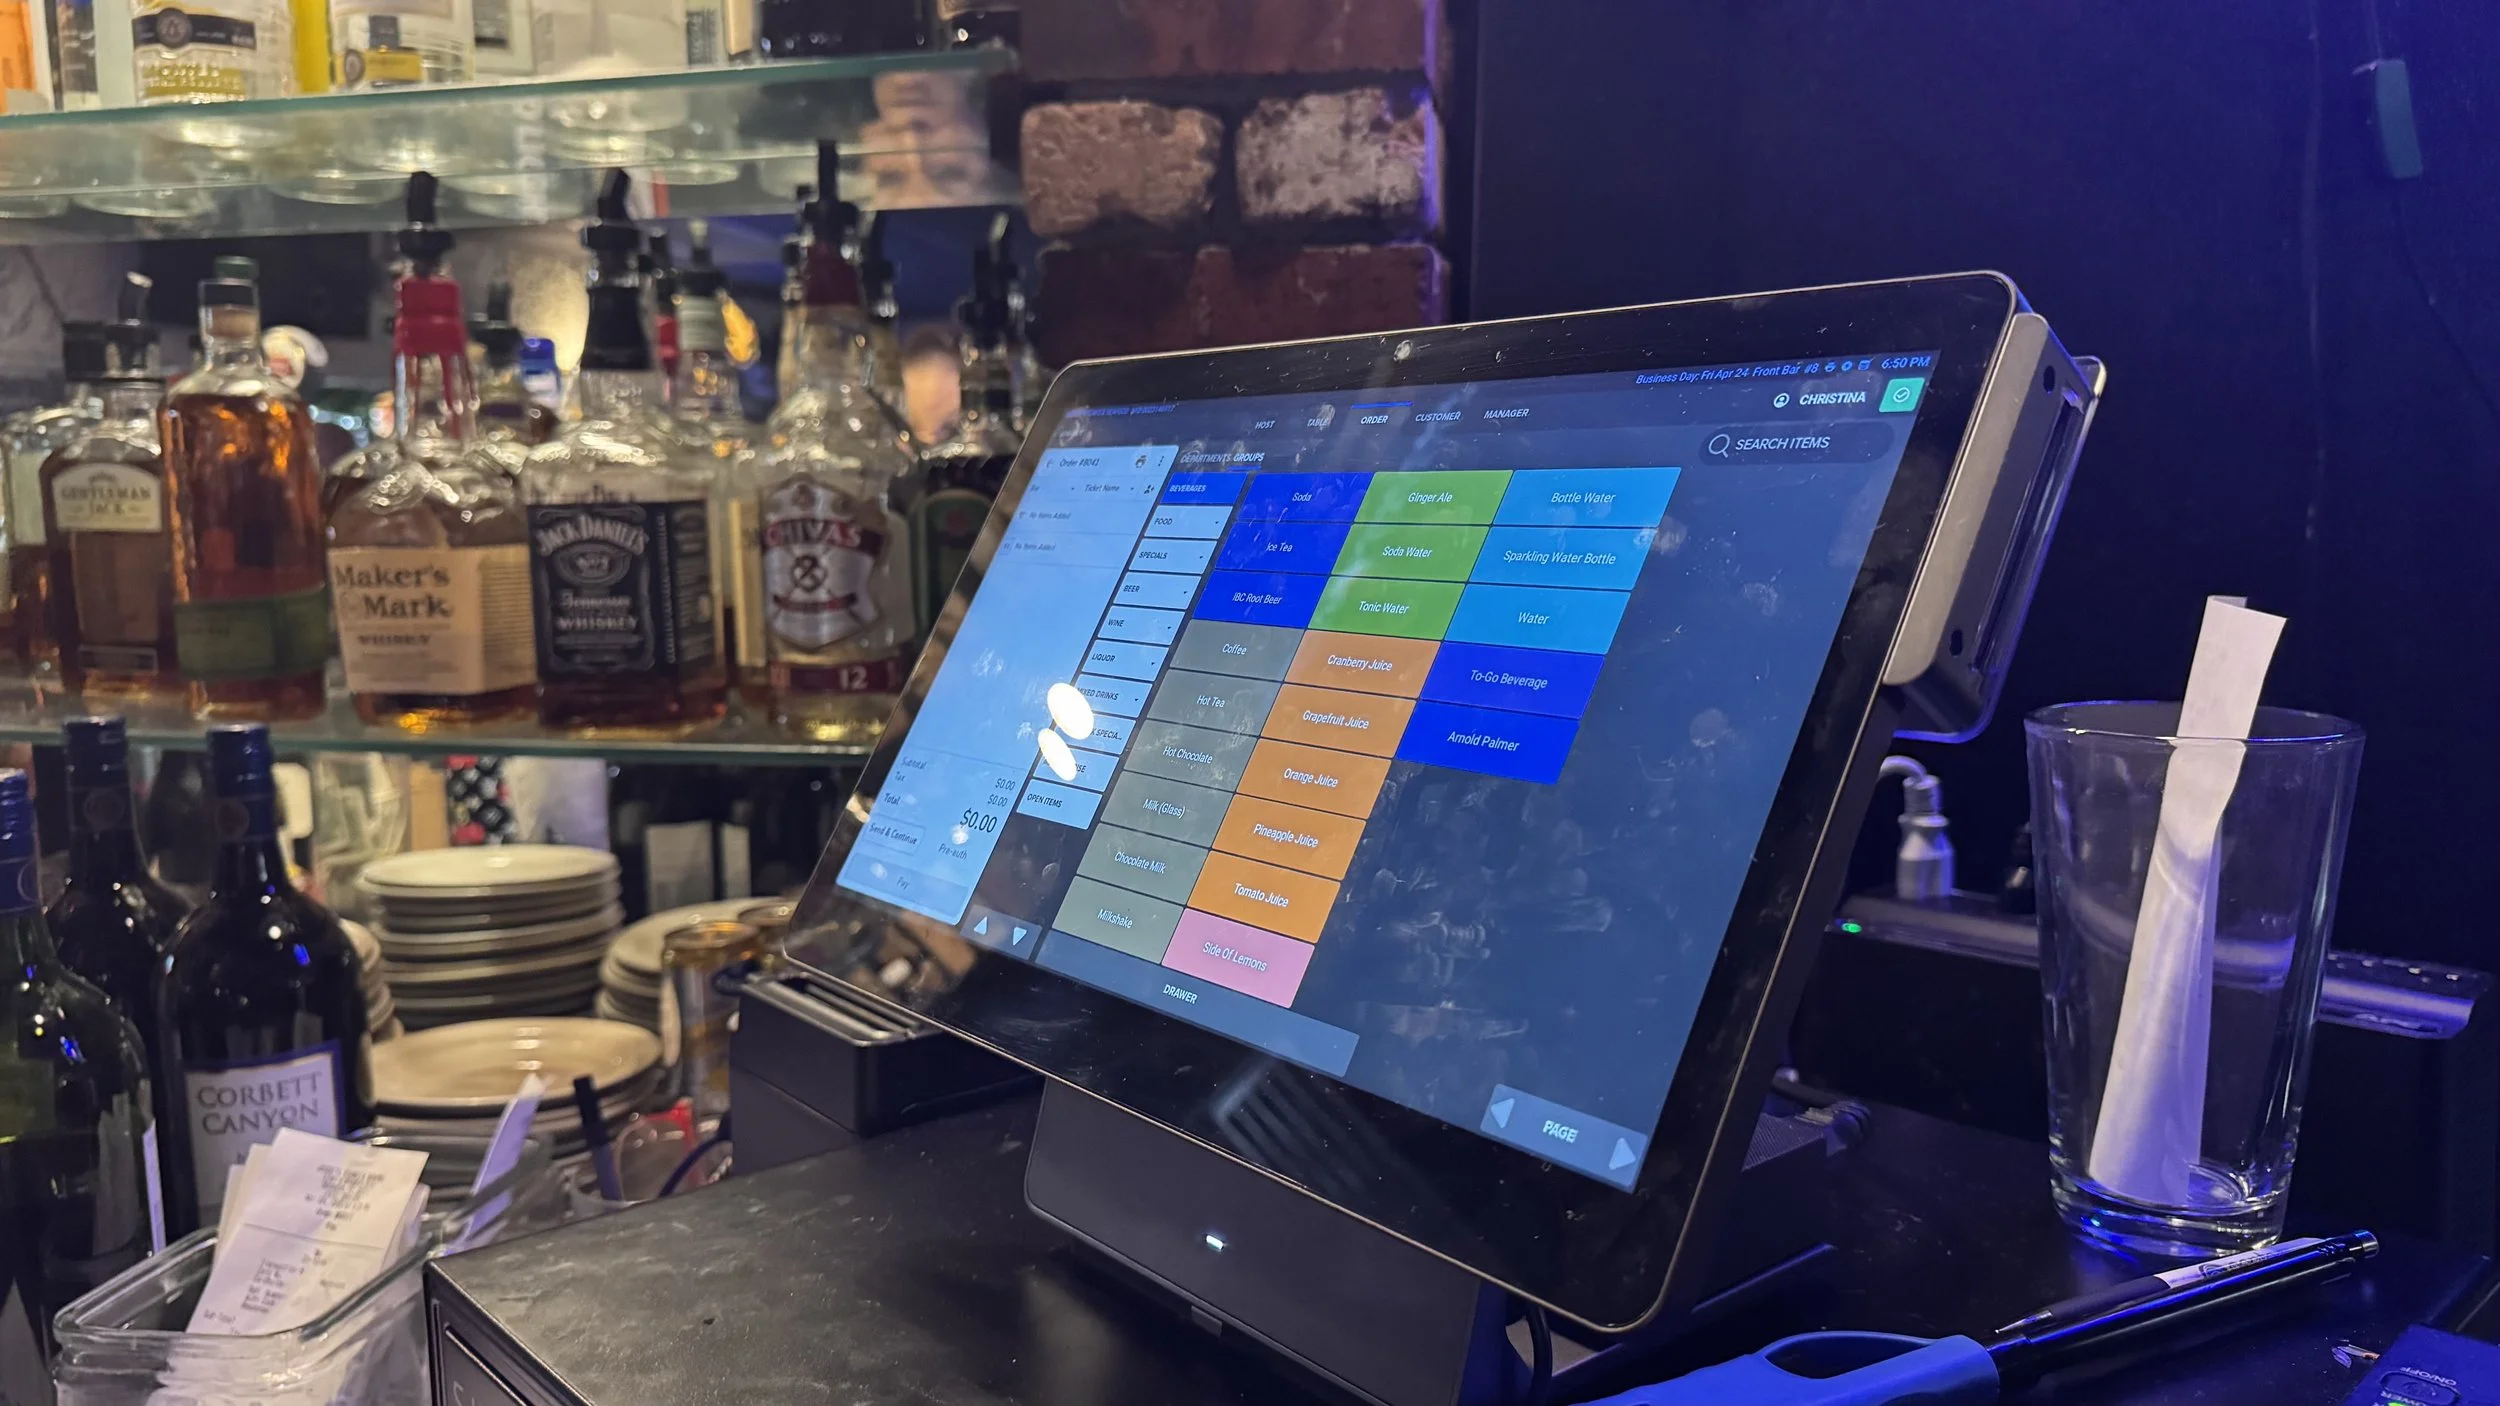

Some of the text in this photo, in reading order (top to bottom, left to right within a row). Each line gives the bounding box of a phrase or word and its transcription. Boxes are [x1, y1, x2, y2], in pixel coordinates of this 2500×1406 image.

[1881, 356, 1931, 370] 6:50 PM
[1636, 374, 1677, 385] Business
[1700, 369, 1715, 380] Fri
[1716, 368, 1733, 380] Apr
[1734, 367, 1749, 379] 24
[1753, 365, 1780, 377] Front
[1781, 364, 1800, 376] Bar
[1803, 362, 1819, 374] #8
[1799, 391, 1866, 406] CHRISTINA
[1360, 415, 1389, 425] ORDER
[1415, 411, 1461, 423] CUSTOMER
[1483, 408, 1530, 420] MANAGER
[1255, 420, 1276, 430] HOST
[1735, 436, 1831, 451] SEARCH ITEMS
[1180, 451, 1265, 464] DEPARTMENTS GROUPS
[1169, 484, 1207, 493] BEVERAGES
[1292, 491, 1312, 502] Soda
[1408, 492, 1453, 505] Ginger Ale
[1551, 492, 1616, 504] Bottle Water
[1154, 517, 1173, 526] FOOD
[764, 519, 862, 548] CHIVAS
[1266, 542, 1293, 553] Ice Tea
[1382, 545, 1433, 558] Soda Water
[1138, 551, 1168, 560] SPECIALS
[1503, 549, 1616, 566] Sparkling Water Bottle
[334, 563, 450, 589] Maker's
[1123, 584, 1140, 593] BEER
[363, 593, 456, 619] Mark
[1232, 592, 1282, 605] IBC Root Beer
[1359, 600, 1409, 614] Tonic Water
[1108, 618, 1125, 627] WINE
[1517, 611, 1550, 625] Water
[1222, 643, 1247, 656] Coffee
[1091, 653, 1116, 662] LIQUOR
[1327, 654, 1393, 672] Cranberry Juice
[839, 665, 869, 690] 12
[1470, 669, 1548, 691] To-Go Beverage
[1095, 690, 1119, 701] DRINKS
[1197, 695, 1225, 708] Hot Tea
[1302, 709, 1370, 730] Grapefruit Juice
[1447, 731, 1520, 752] Arnold Palmer
[1162, 745, 1213, 765] Hot Chocolate
[995, 778, 1016, 792] $0.00
[1284, 768, 1338, 789] Orange Juice
[884, 793, 900, 806] Total
[987, 794, 1008, 808] $0.00
[1026, 793, 1063, 809] OPEN ITEMS
[1142, 799, 1185, 820] Milk (Glass)
[960, 808, 998, 833] $0.00
[869, 822, 885, 837] Send
[1253, 823, 1319, 849] Pineapple Juice
[1114, 851, 1166, 875] Chocolate Milk
[1234, 882, 1289, 909] Tomato Juice
[1097, 909, 1133, 929] Milkshake
[1202, 941, 1267, 972] Side Of Lemons
[1163, 984, 1198, 1004] DRAWER
[197, 1070, 322, 1110] CORBETT
[202, 1099, 319, 1137] CANYON
[1542, 1119, 1579, 1144] PAGE
[2400, 1366, 2457, 1386] ON/OFF
